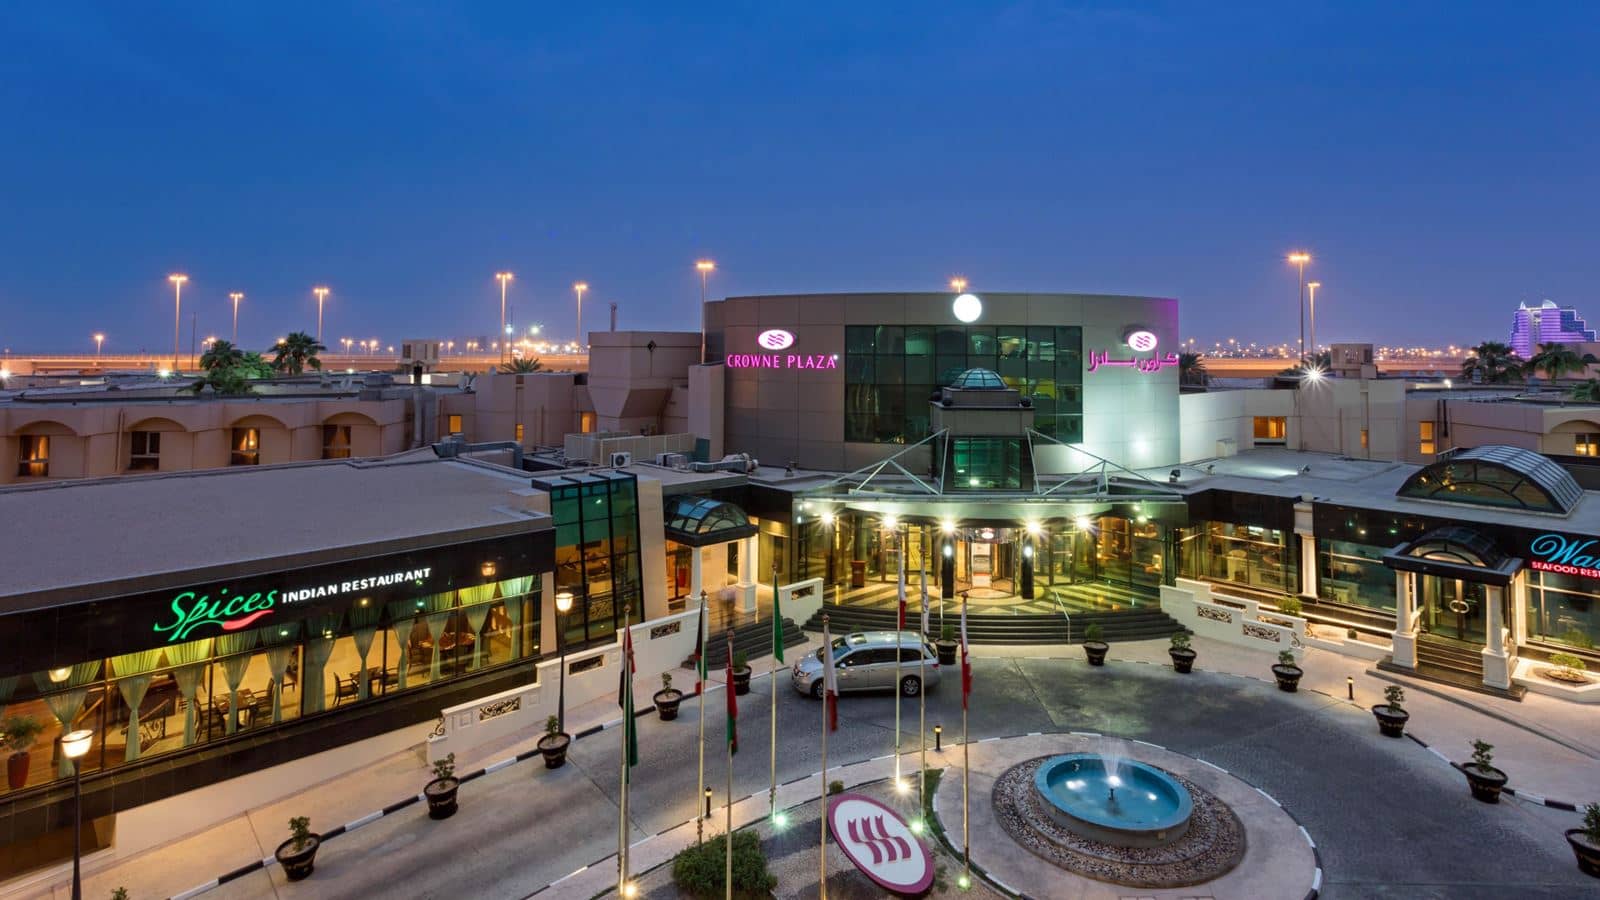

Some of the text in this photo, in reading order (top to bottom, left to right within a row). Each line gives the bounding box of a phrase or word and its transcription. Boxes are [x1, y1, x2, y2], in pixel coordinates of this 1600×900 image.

[727, 354, 837, 369] CROWNE PLAZA
[1530, 534, 1600, 570] Wa
[1531, 561, 1578, 574] SEAFOOD
[153, 567, 432, 641] Spices INDIAN RESTAURANT
